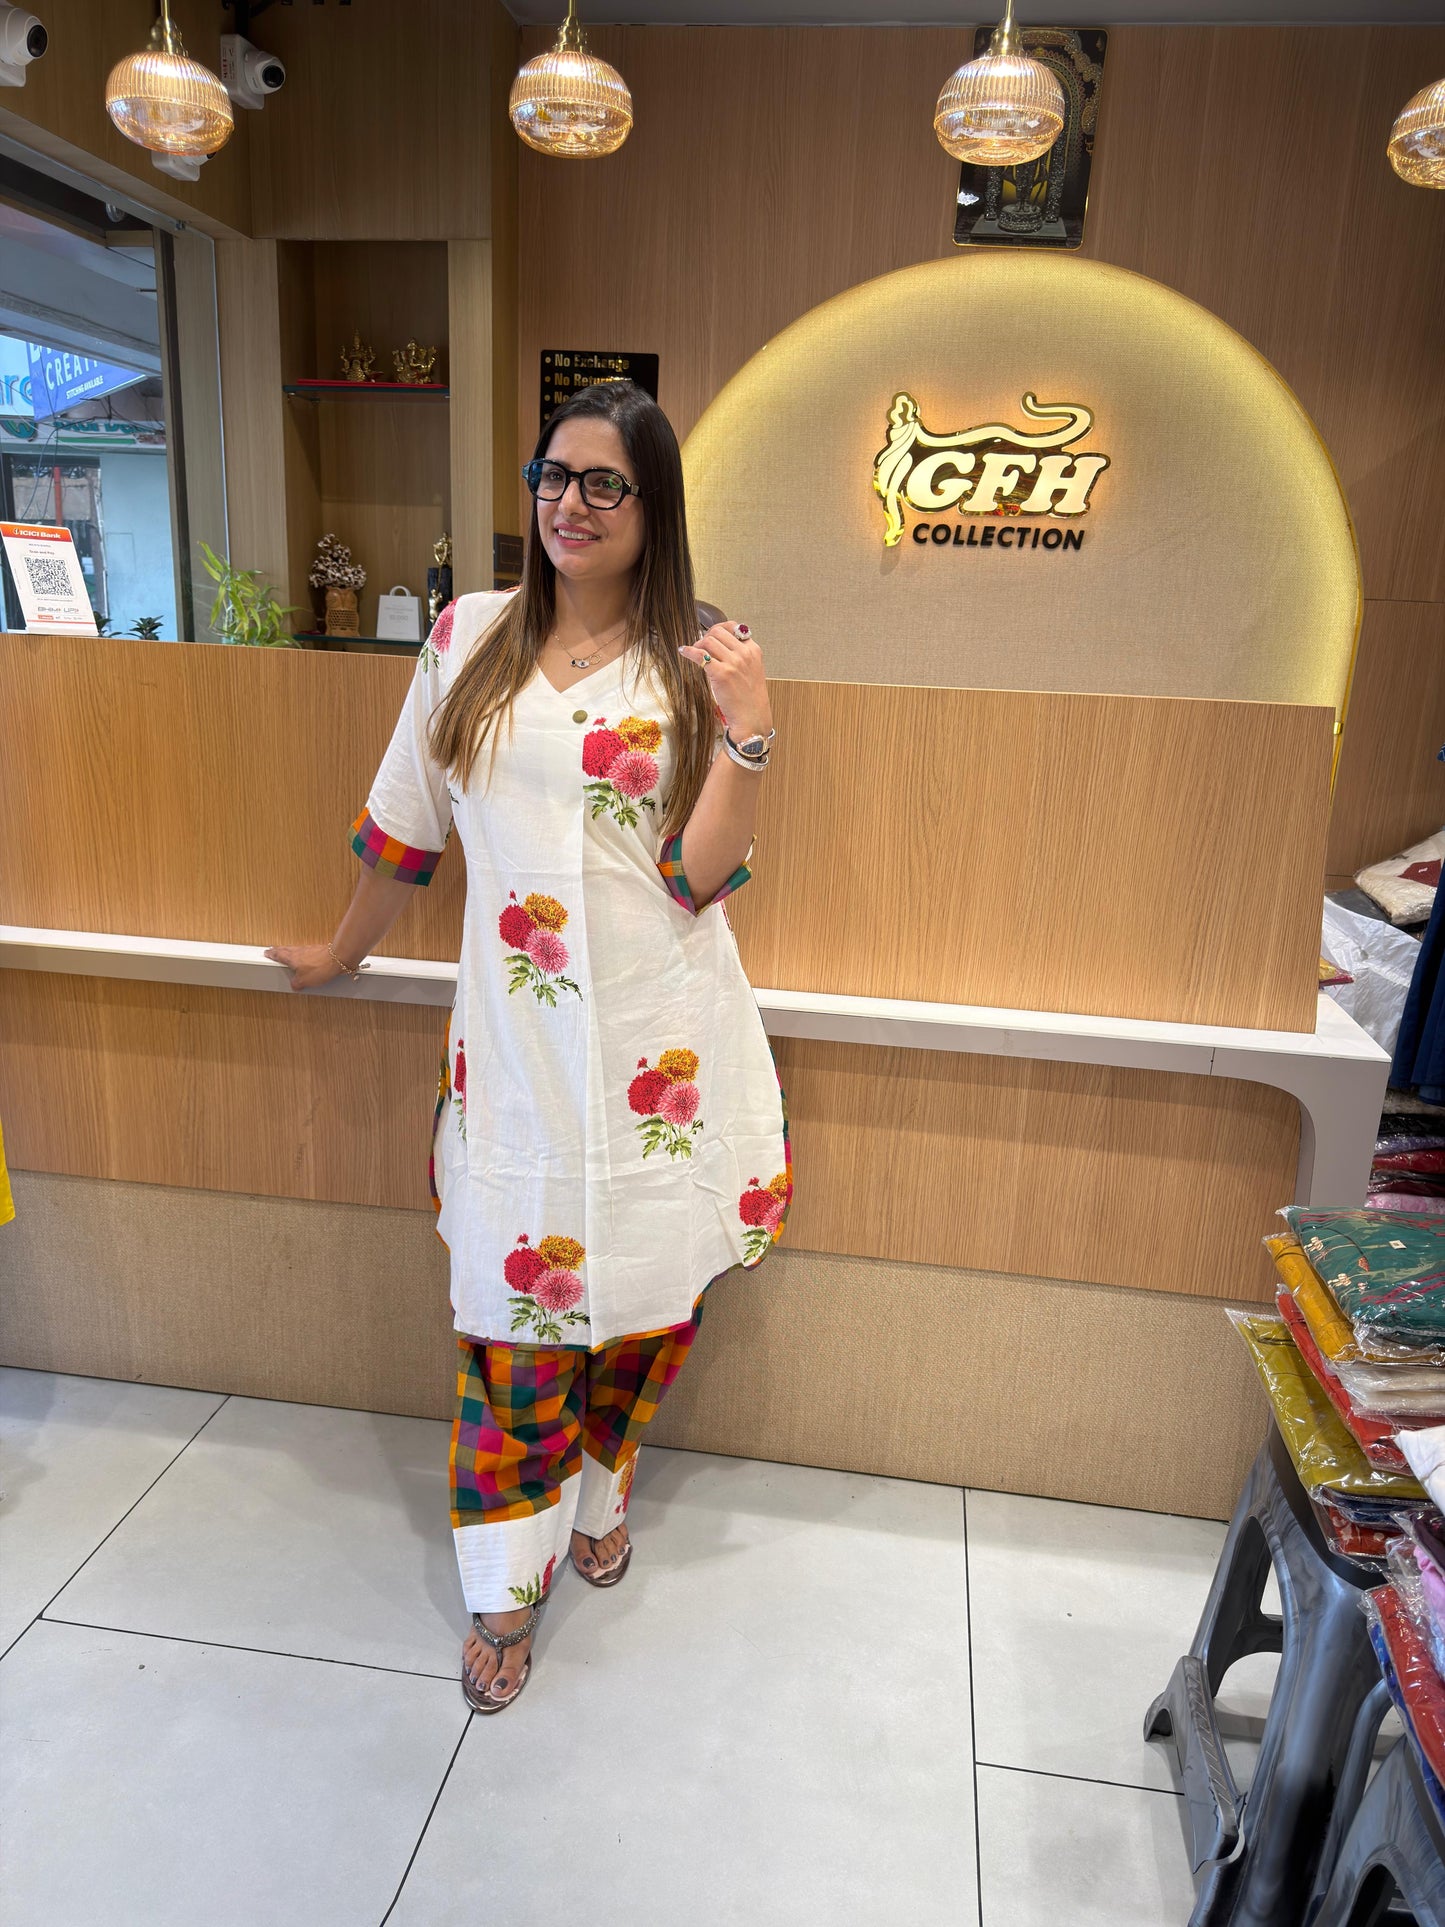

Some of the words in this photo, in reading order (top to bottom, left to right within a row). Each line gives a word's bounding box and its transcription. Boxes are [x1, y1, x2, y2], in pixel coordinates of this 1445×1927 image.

[554, 353, 571, 367] No
[574, 354, 630, 372] Exchange
[554, 373, 570, 386] No
[554, 391, 570, 404] No
[905, 449, 1109, 514] GFH
[912, 522, 1085, 551] COLLECTION
